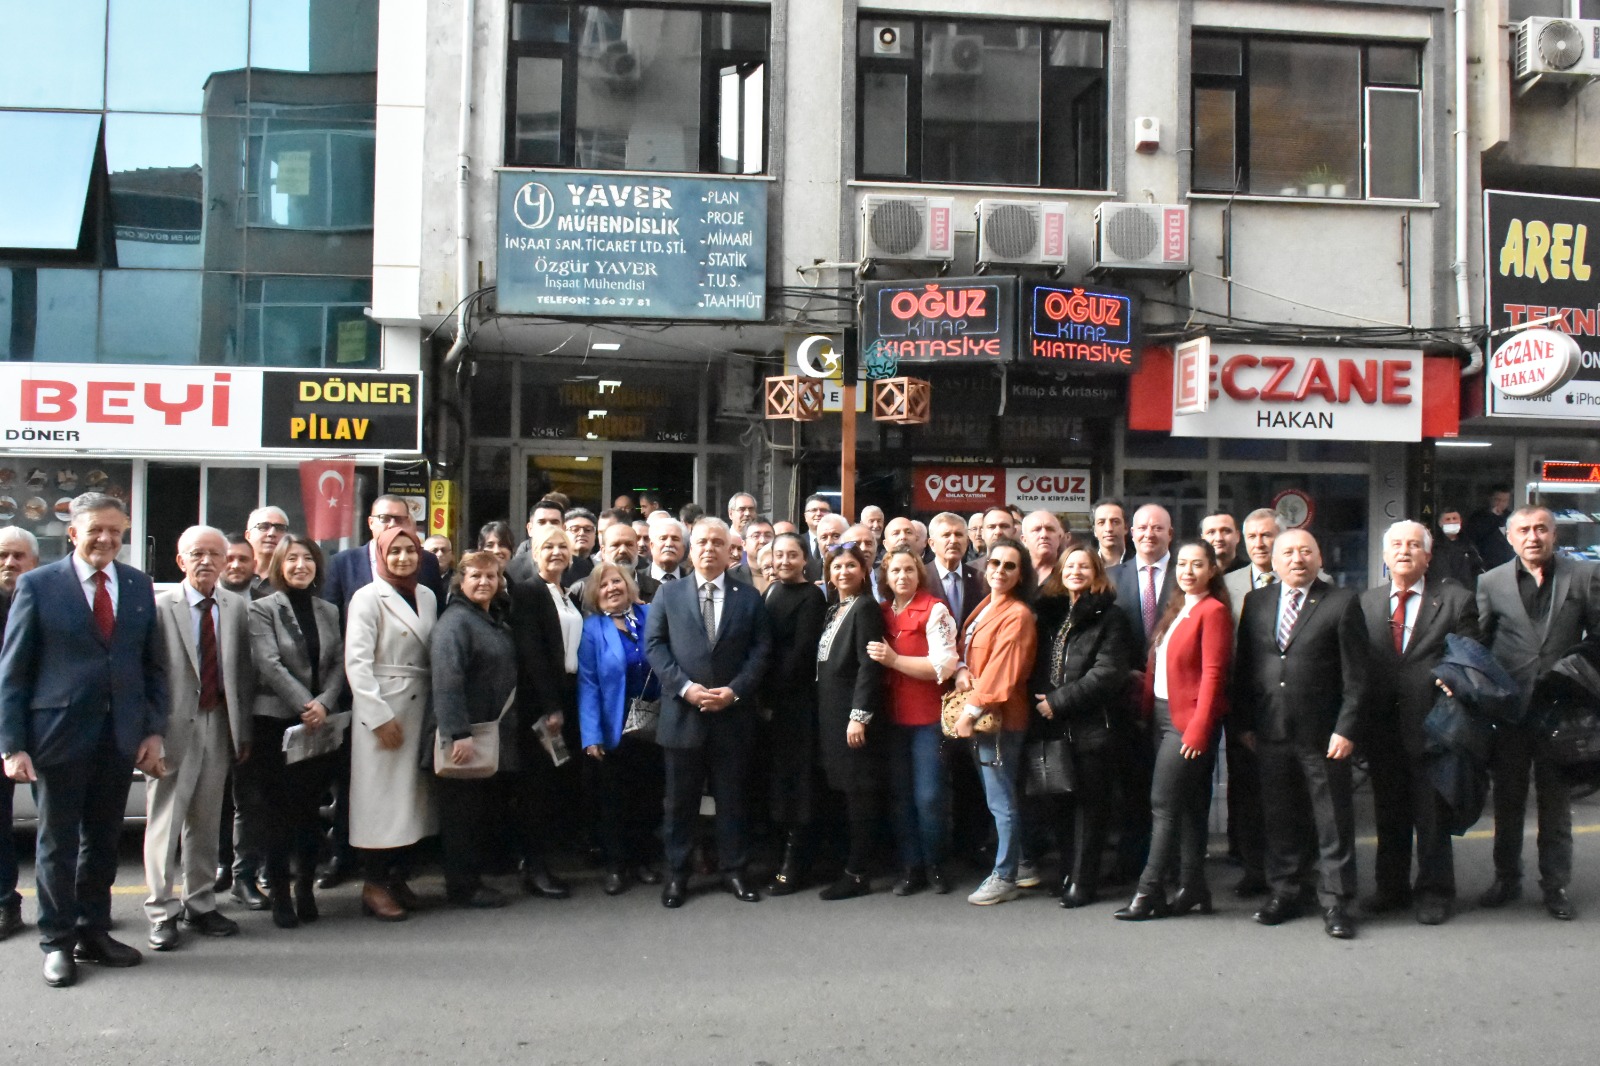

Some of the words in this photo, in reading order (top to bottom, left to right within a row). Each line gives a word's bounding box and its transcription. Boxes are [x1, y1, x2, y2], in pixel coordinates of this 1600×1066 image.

[567, 184, 673, 210] YAVER
[708, 191, 739, 204] PLAN
[557, 208, 680, 235] MÜHENDİSLİK
[707, 211, 744, 225] PROJE
[707, 229, 752, 246] MİMARİ
[935, 208, 946, 250] VESTEL
[1050, 215, 1059, 255] VESTEL
[1169, 212, 1181, 260] VESTEL
[505, 233, 551, 250] İNŞAAT
[1499, 218, 1591, 283] AREL
[535, 256, 589, 276] Özgür
[595, 260, 658, 276] YAVER
[708, 251, 747, 267] STATİK
[545, 274, 580, 290] İnşaat
[584, 277, 645, 290] Mühendisi
[707, 273, 741, 287] T.U.S.
[593, 297, 616, 305] 260
[619, 297, 634, 306] 37
[637, 298, 651, 306] 81
[704, 292, 762, 308] TAAHHÜT
[891, 284, 986, 319] OĞUZ
[1044, 287, 1121, 326] OĞUZ
[907, 318, 968, 336] KİTAP
[1056, 320, 1107, 341] KİTAP
[1032, 339, 1132, 365] KIRTASİYE
[1495, 339, 1555, 369] ECZANE
[1501, 367, 1546, 388] HAKAN
[20, 372, 232, 427] BEYİ
[299, 377, 411, 404] DÖNER
[1049, 386, 1058, 398] &
[290, 412, 369, 441] PİLAV
[1256, 411, 1333, 429] HAKAN
[6, 427, 80, 441] DÖNER
[1048, 494, 1085, 502] KIRTASİYE
